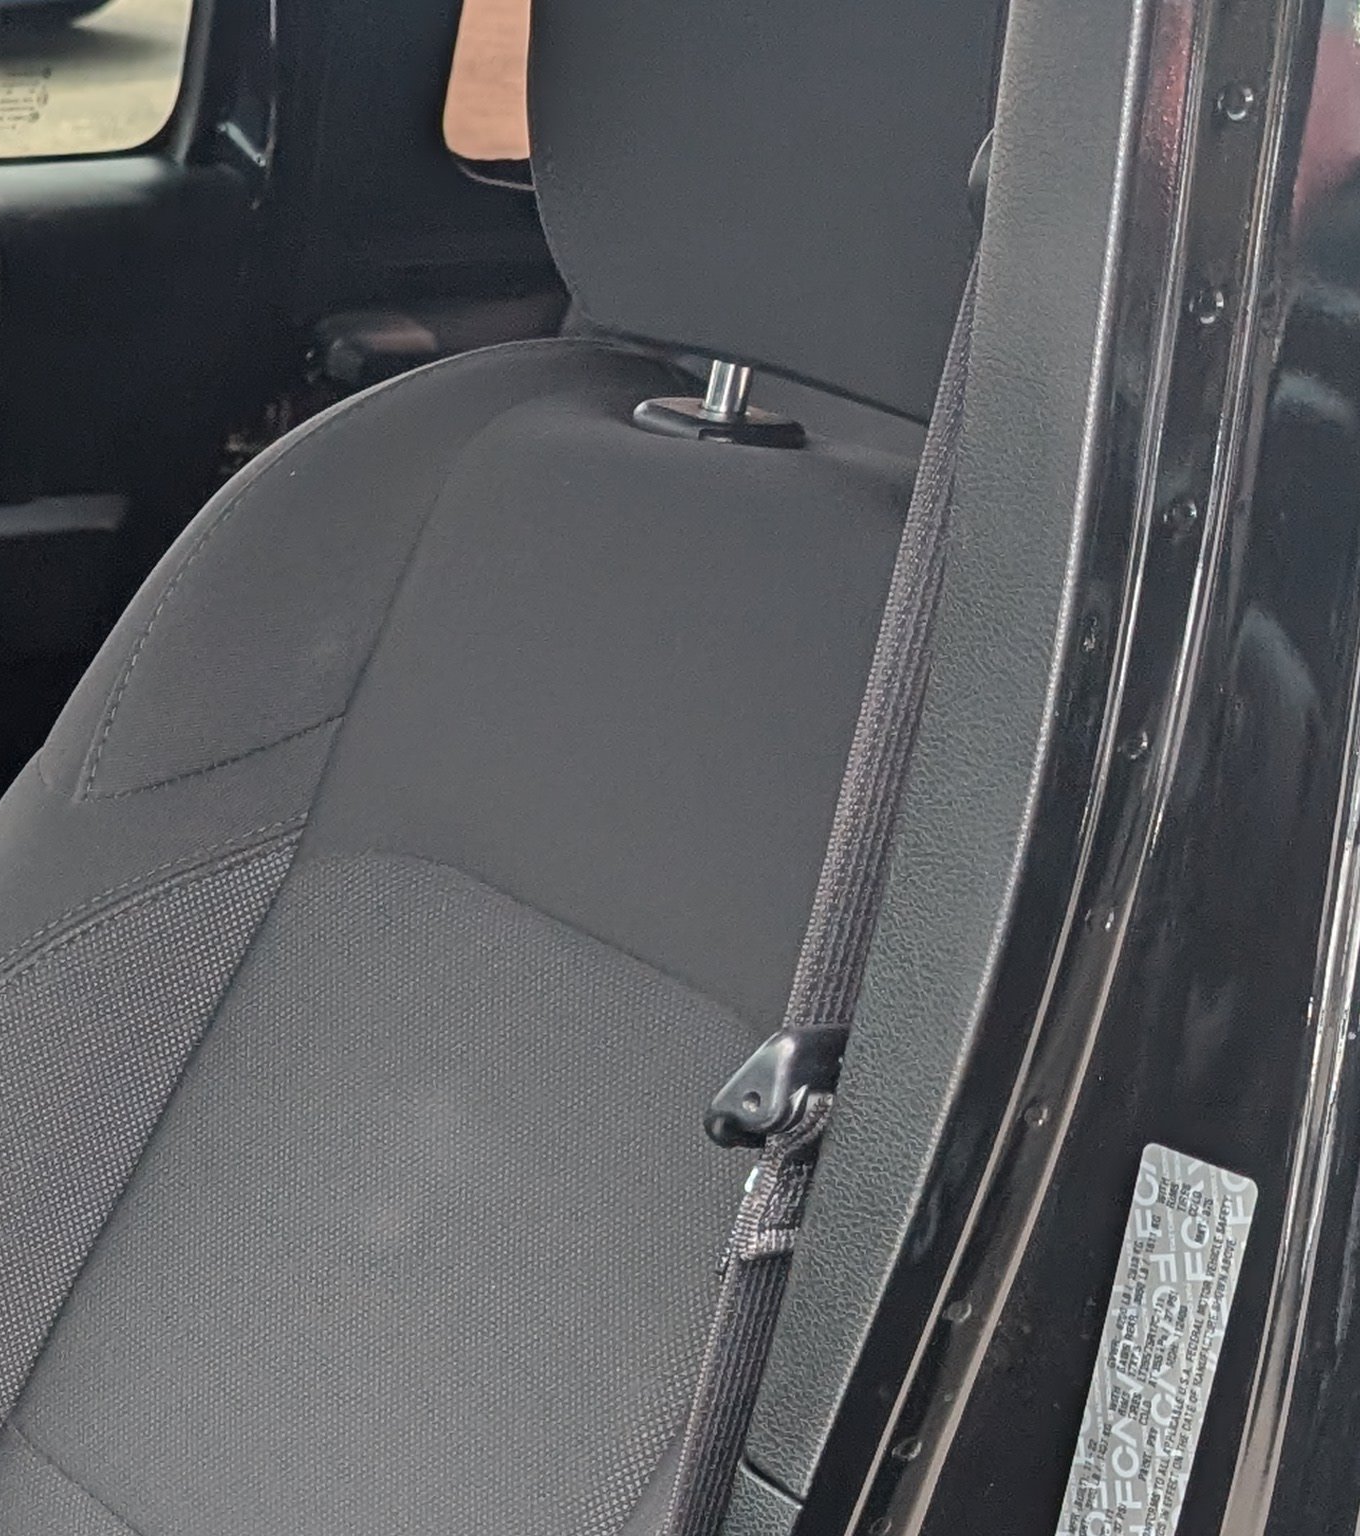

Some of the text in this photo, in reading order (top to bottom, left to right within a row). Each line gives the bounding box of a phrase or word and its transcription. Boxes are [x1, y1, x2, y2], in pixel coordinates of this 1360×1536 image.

[1216, 1194, 1233, 1235] SAFETY
[1158, 1457, 1168, 1477] ALL
[1154, 1477, 1164, 1491] TO
